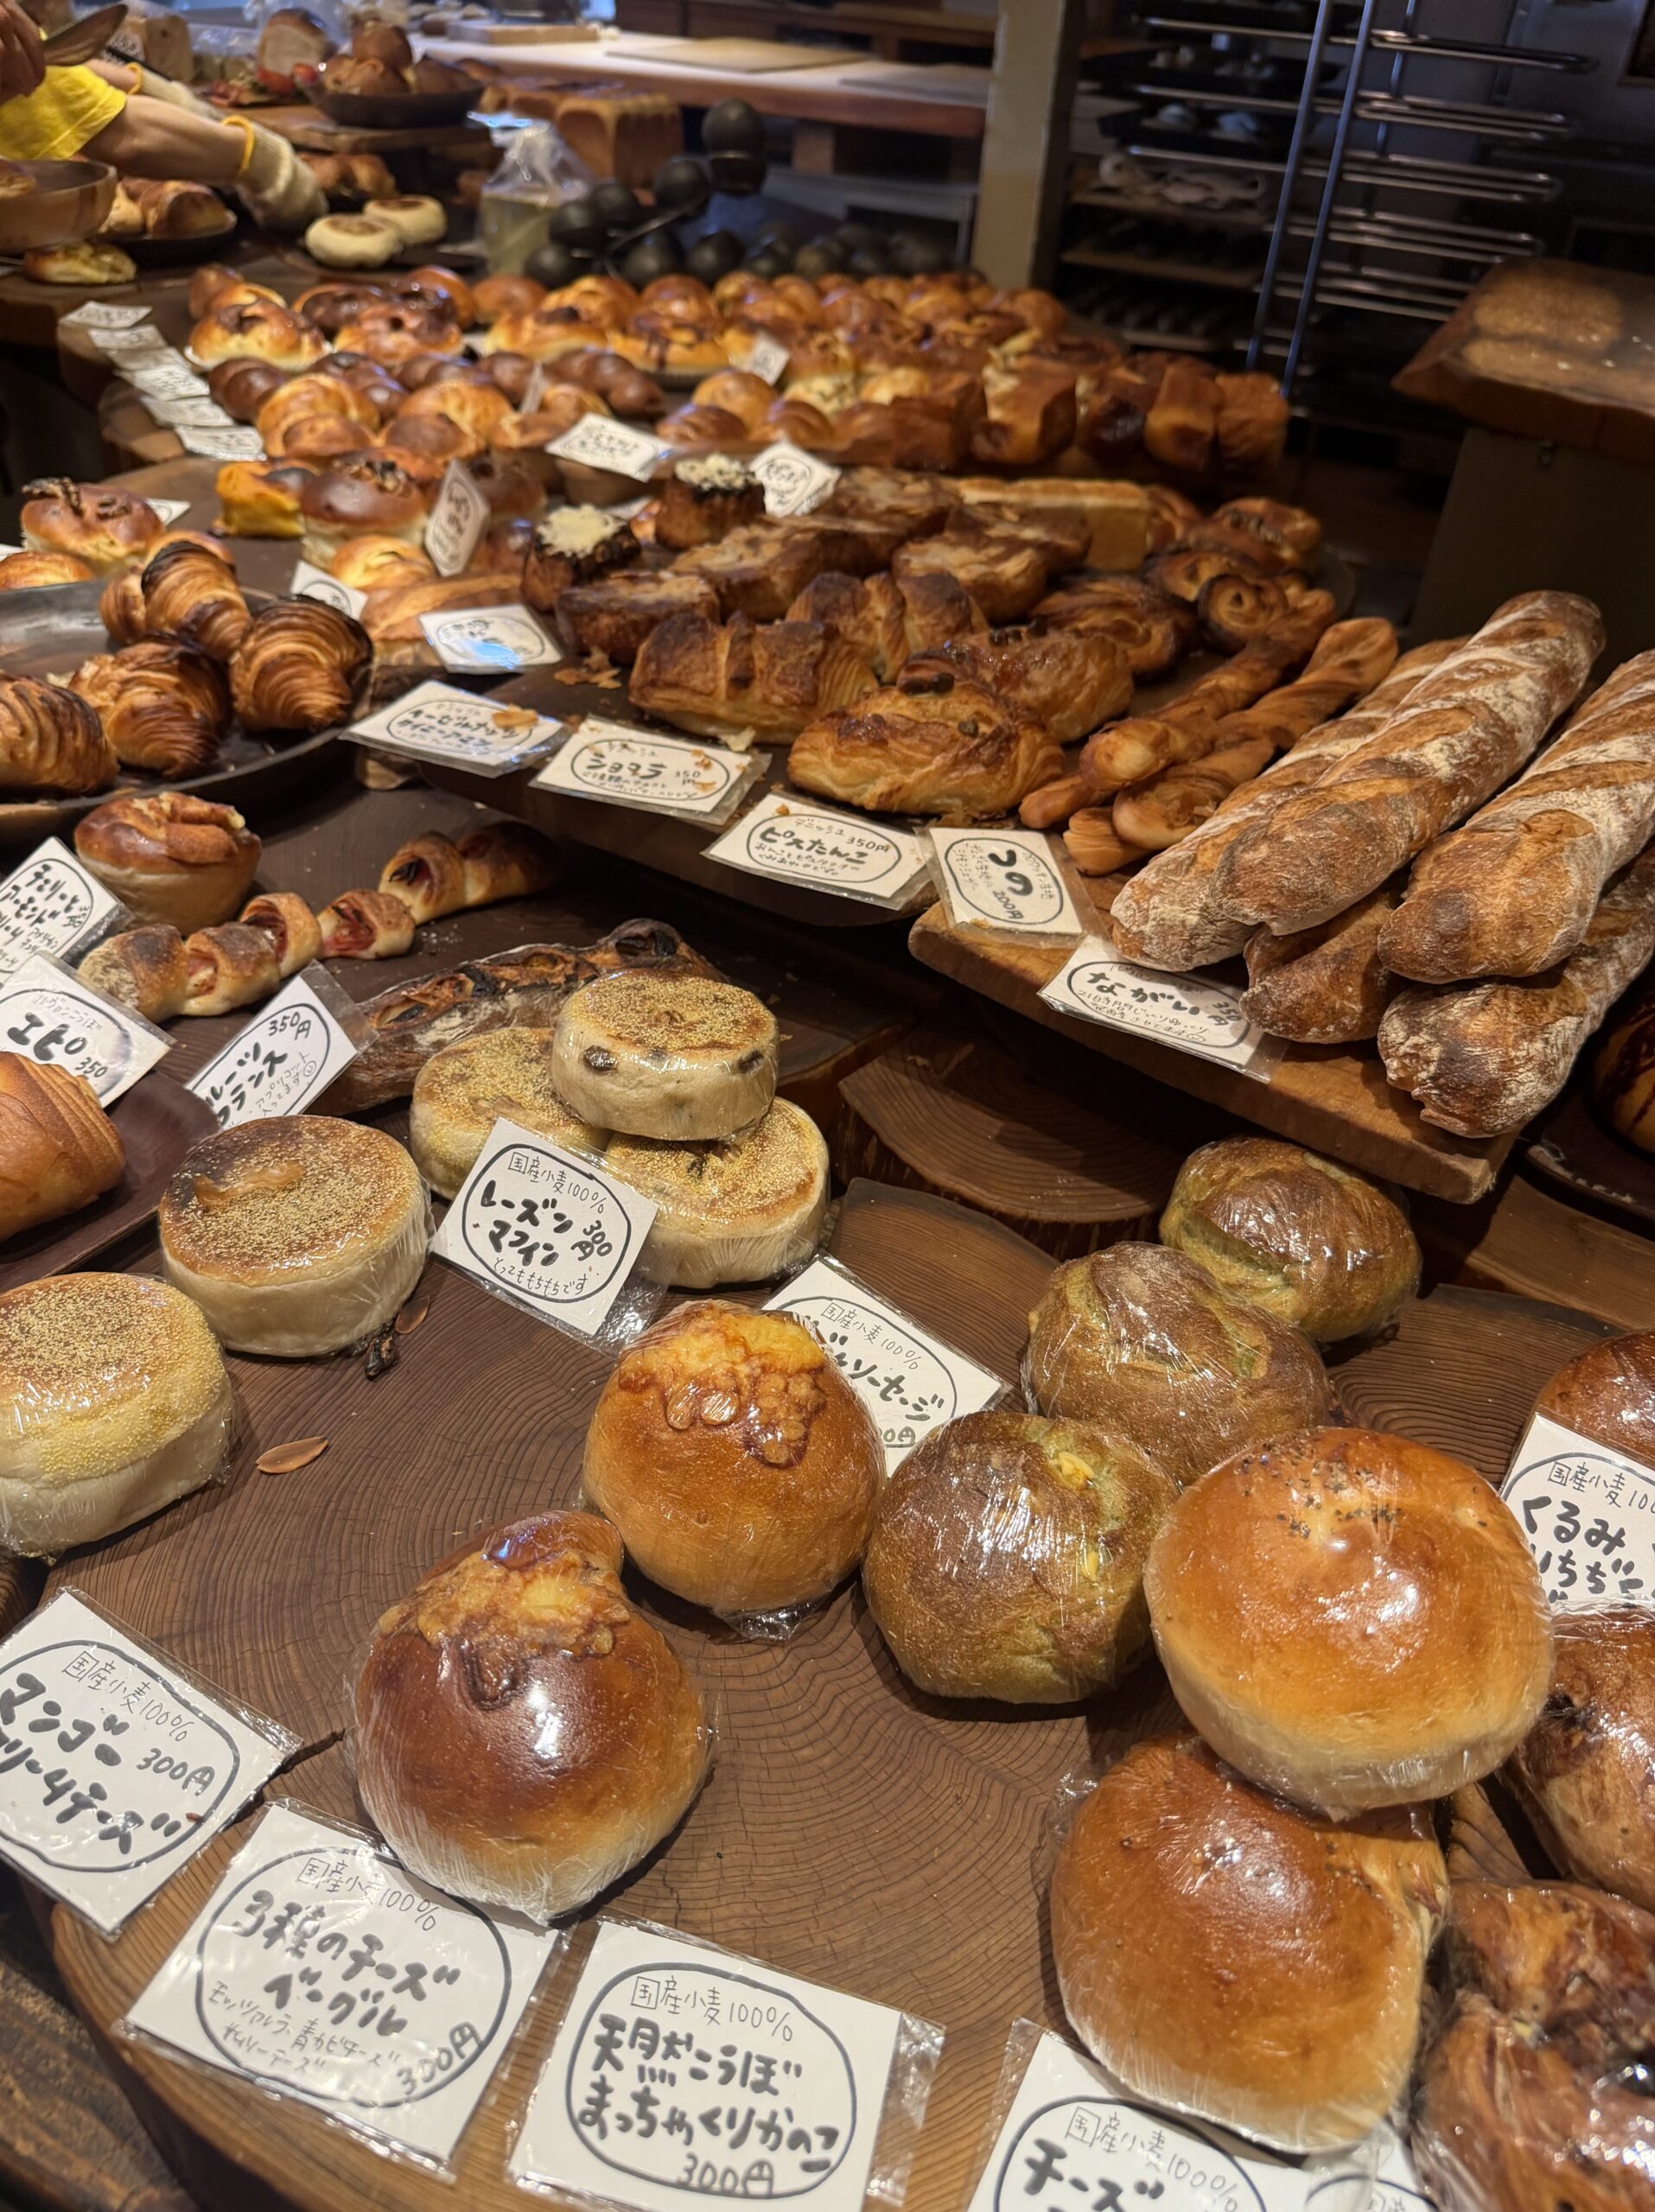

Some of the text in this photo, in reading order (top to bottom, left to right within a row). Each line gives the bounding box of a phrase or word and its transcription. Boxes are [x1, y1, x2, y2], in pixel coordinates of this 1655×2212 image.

[585, 752, 668, 780] ショコラ
[759, 825, 869, 865] ピスたんこ
[845, 836, 890, 854] 350円
[987, 849, 1034, 897] つの
[993, 889, 1024, 920] 200円
[1086, 971, 1201, 1016] ながい
[7, 1011, 88, 1062] エピ
[267, 1011, 312, 1041] 350円
[74, 1056, 109, 1078] 350
[205, 1041, 260, 1109] ルーツ
[217, 1050, 289, 1127] フランス
[481, 1179, 574, 1234] レーズン
[507, 1151, 608, 1215] 国産小麦100%
[488, 1219, 560, 1267] マフィン
[493, 1257, 589, 1296] とってももちもちです
[821, 1301, 922, 1370] 国産小麦100%
[1522, 1495, 1655, 1556] くるみ
[0, 1672, 130, 1767] マンゴー
[61, 1650, 196, 1743] 国産小麦100%
[136, 1747, 215, 1797] 300円
[232, 1888, 462, 2002] 3種のチーズ
[264, 1966, 408, 2037] ベーグル
[631, 1974, 793, 2042] 国産小麦100%
[396, 2019, 483, 2095] 300円
[591, 2012, 803, 2095] 天然こうぼ
[577, 2074, 840, 2173] まっちゃくりかのこ
[676, 2152, 774, 2196] 300円
[1023, 2137, 1165, 2212] チーズ
[1064, 2106, 1238, 2212] 国産小麦100%
